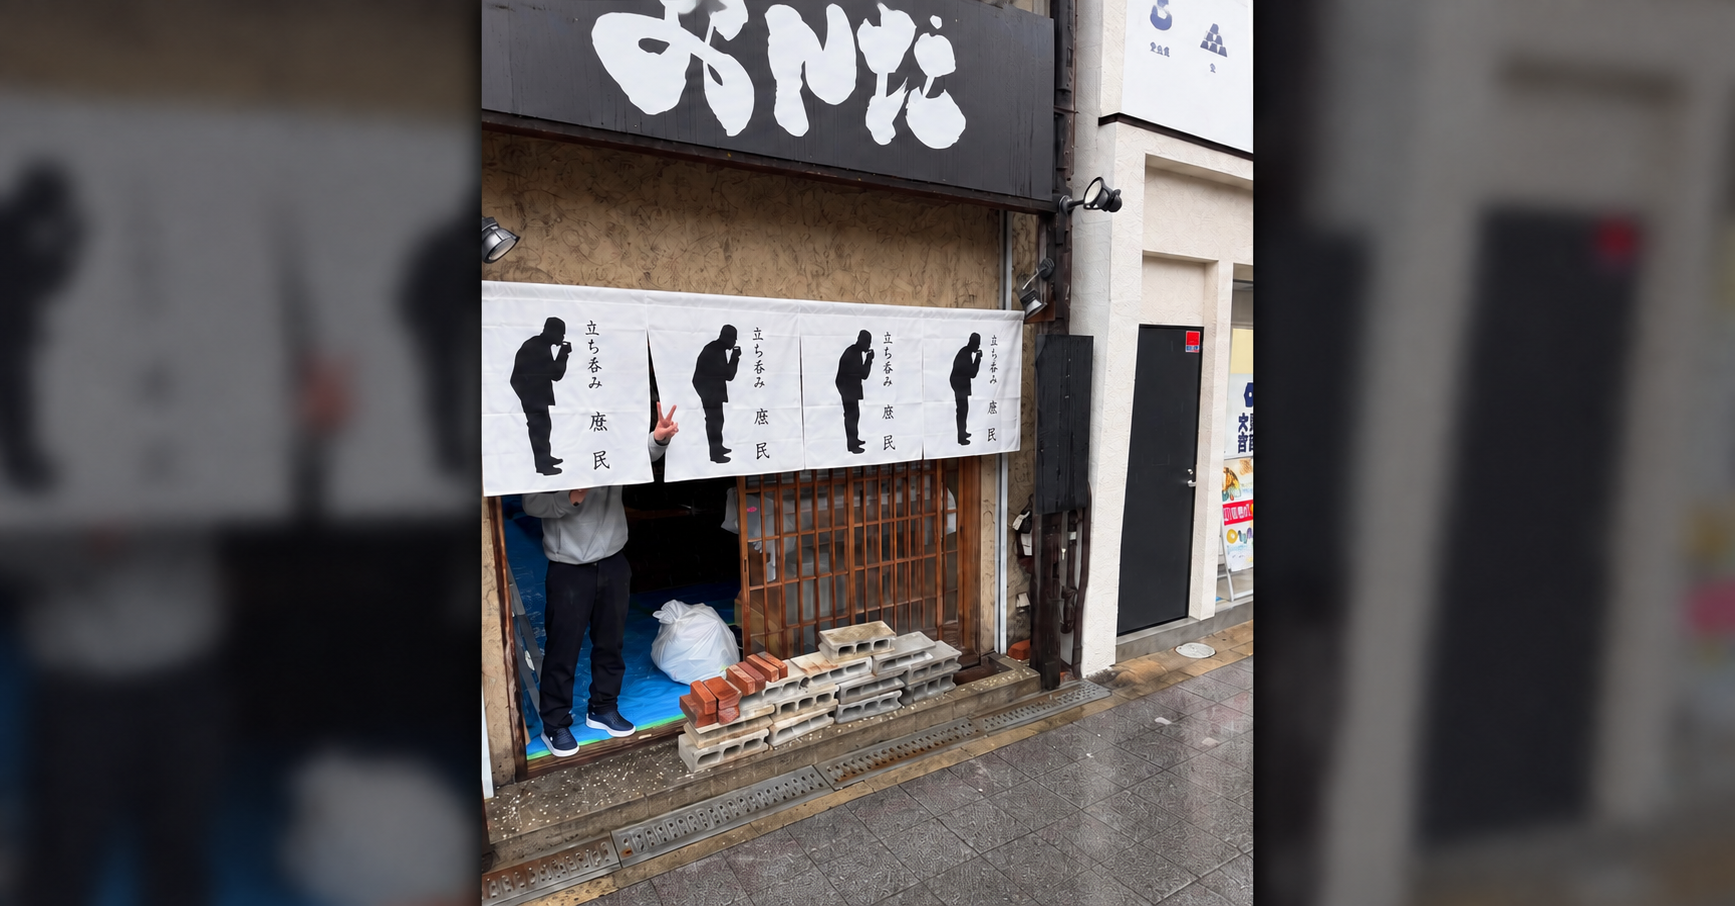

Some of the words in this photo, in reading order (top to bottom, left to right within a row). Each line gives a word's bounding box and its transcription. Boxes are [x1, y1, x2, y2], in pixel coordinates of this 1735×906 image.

[585, 320, 603, 389] 立ち呑み
[752, 327, 765, 388] 立ち呑み
[883, 331, 893, 387] 立ち呑み
[989, 334, 998, 384] 立ち呑み
[589, 411, 610, 471] 庶民
[754, 408, 770, 460] 庶民
[882, 404, 896, 451] 庶民
[987, 400, 998, 442] 庶民
